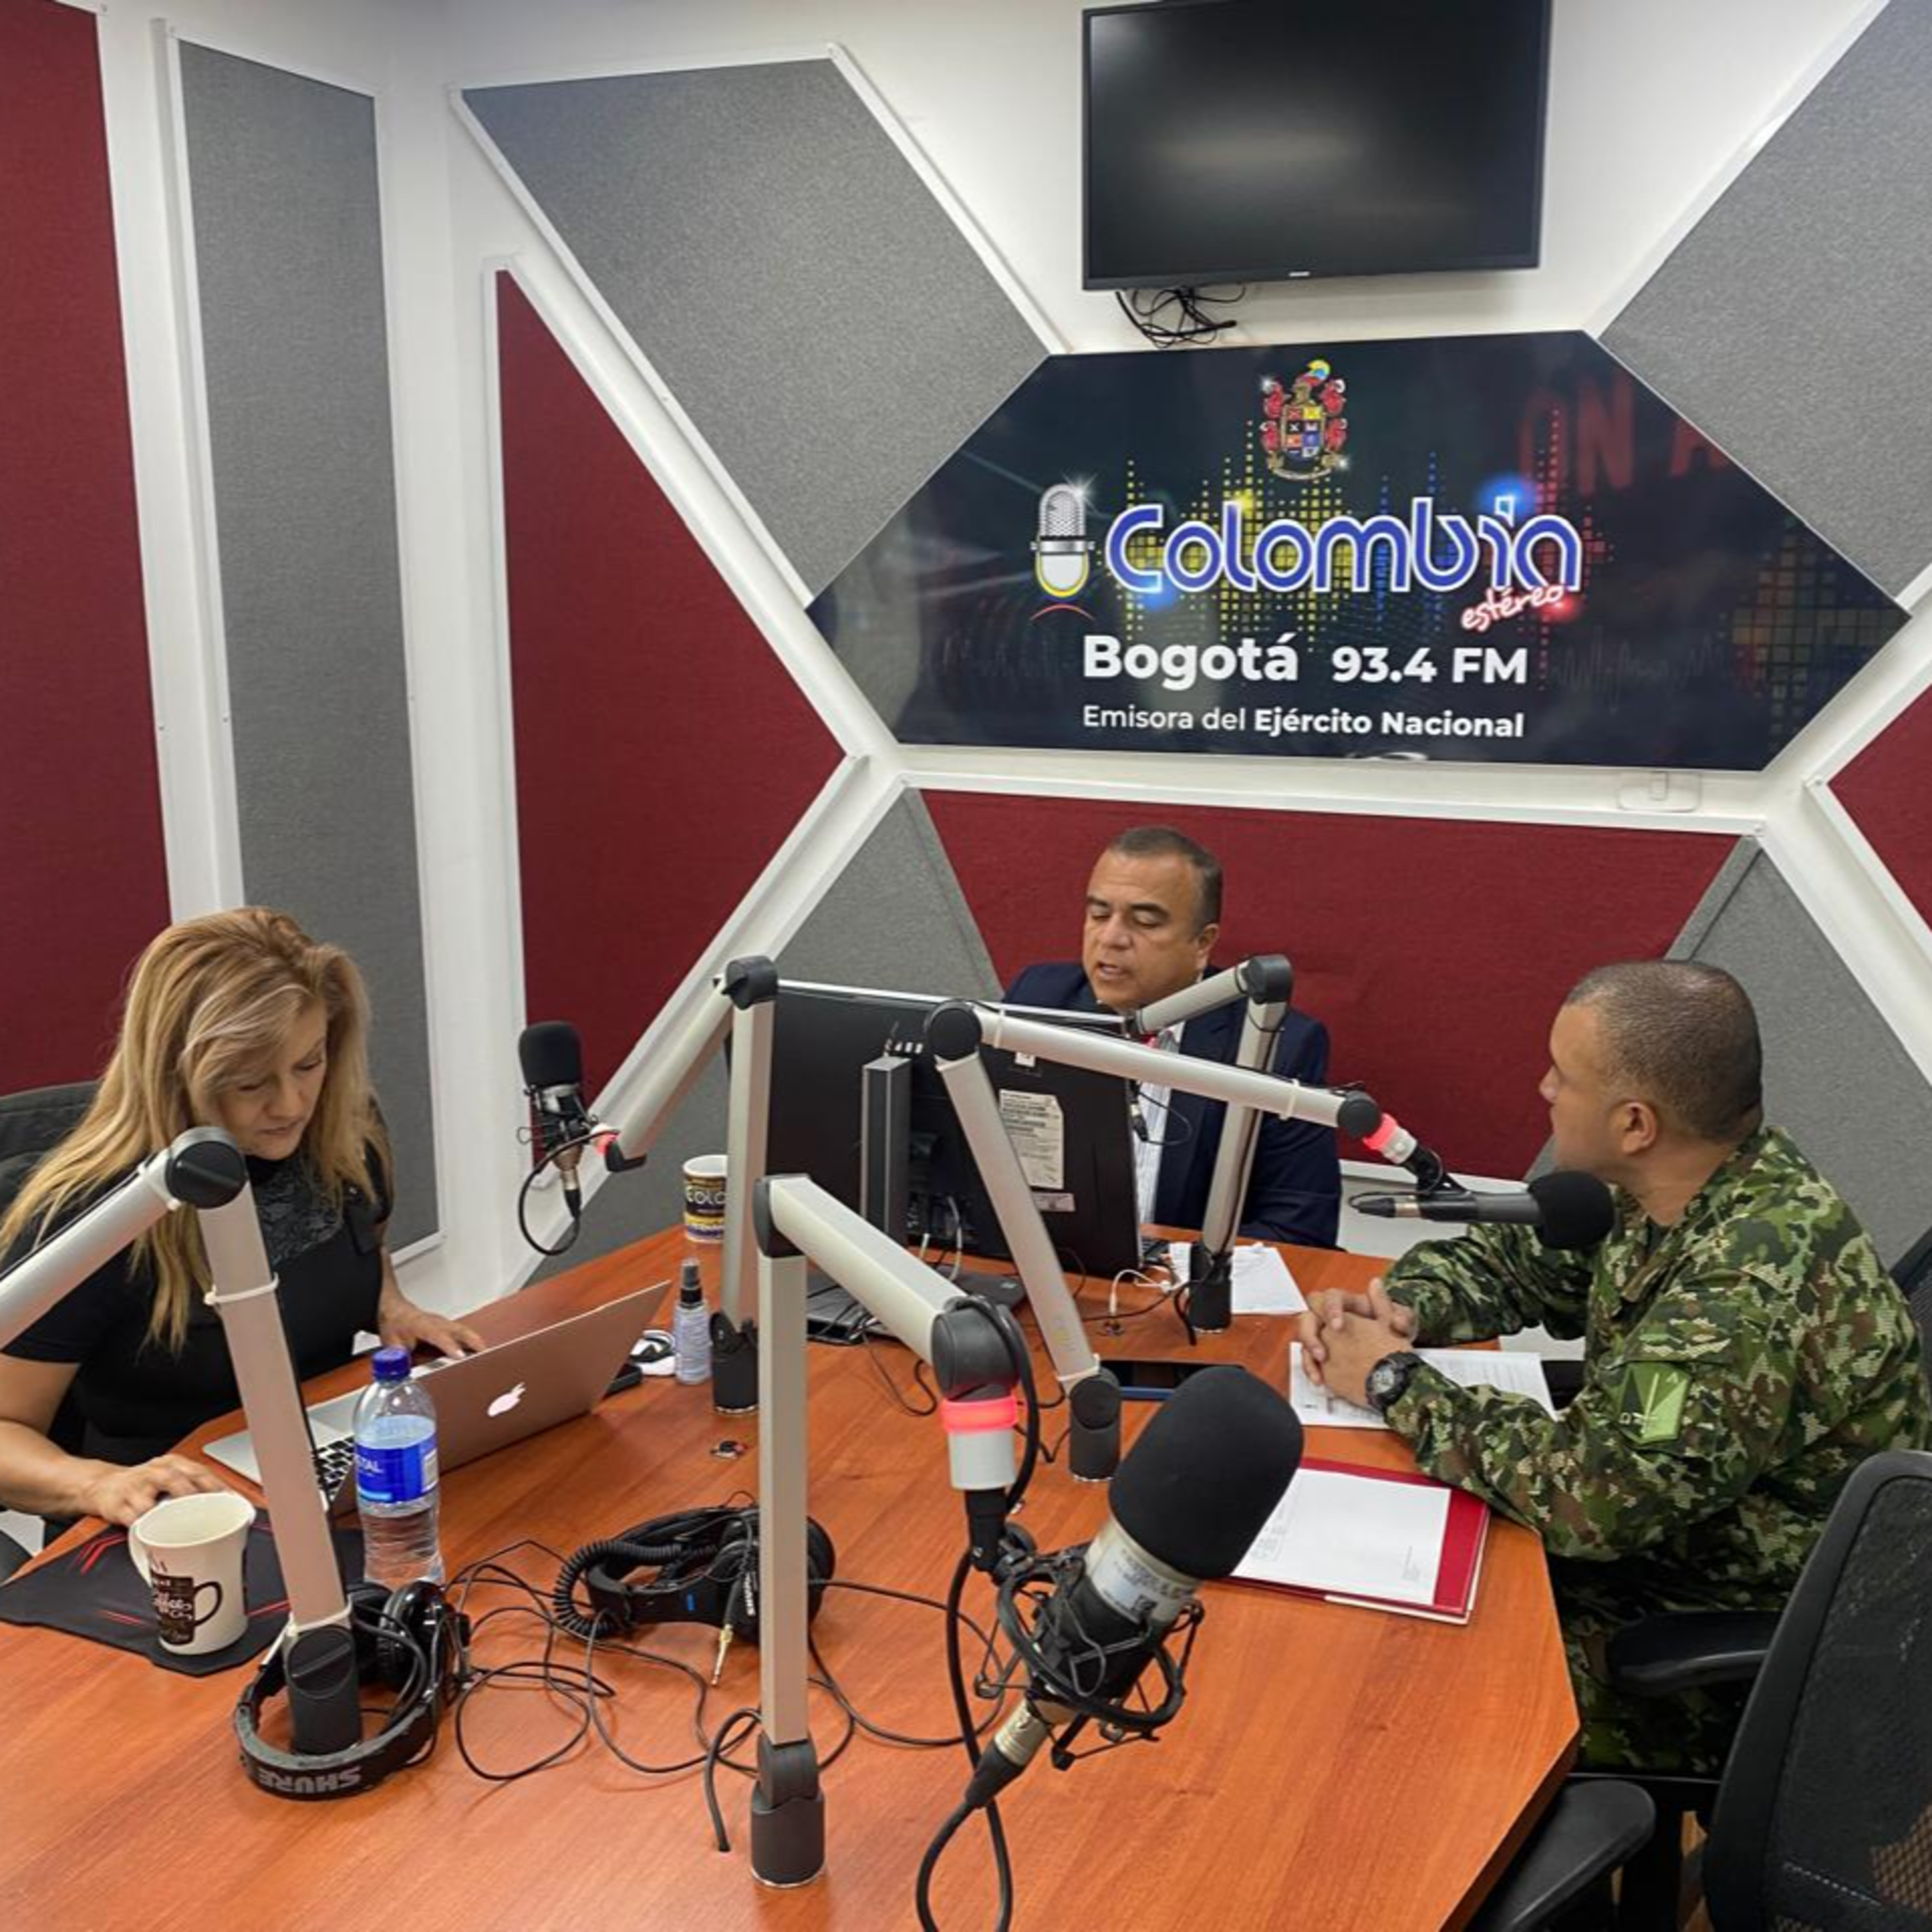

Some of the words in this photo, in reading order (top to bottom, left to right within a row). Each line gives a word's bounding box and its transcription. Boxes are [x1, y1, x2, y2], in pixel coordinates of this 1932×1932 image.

[1104, 497, 1583, 593] Colombia
[1460, 583, 1565, 632] estéreo
[1083, 632, 1298, 690] Bogotá
[1331, 647, 1437, 684] 93.4
[1452, 648, 1528, 684] FM
[1083, 704, 1194, 730] Emisora
[1202, 706, 1246, 731] del
[1254, 707, 1372, 737] Ejército
[1380, 710, 1524, 738] Nacional
[259, 1766, 361, 1794] SHURE
